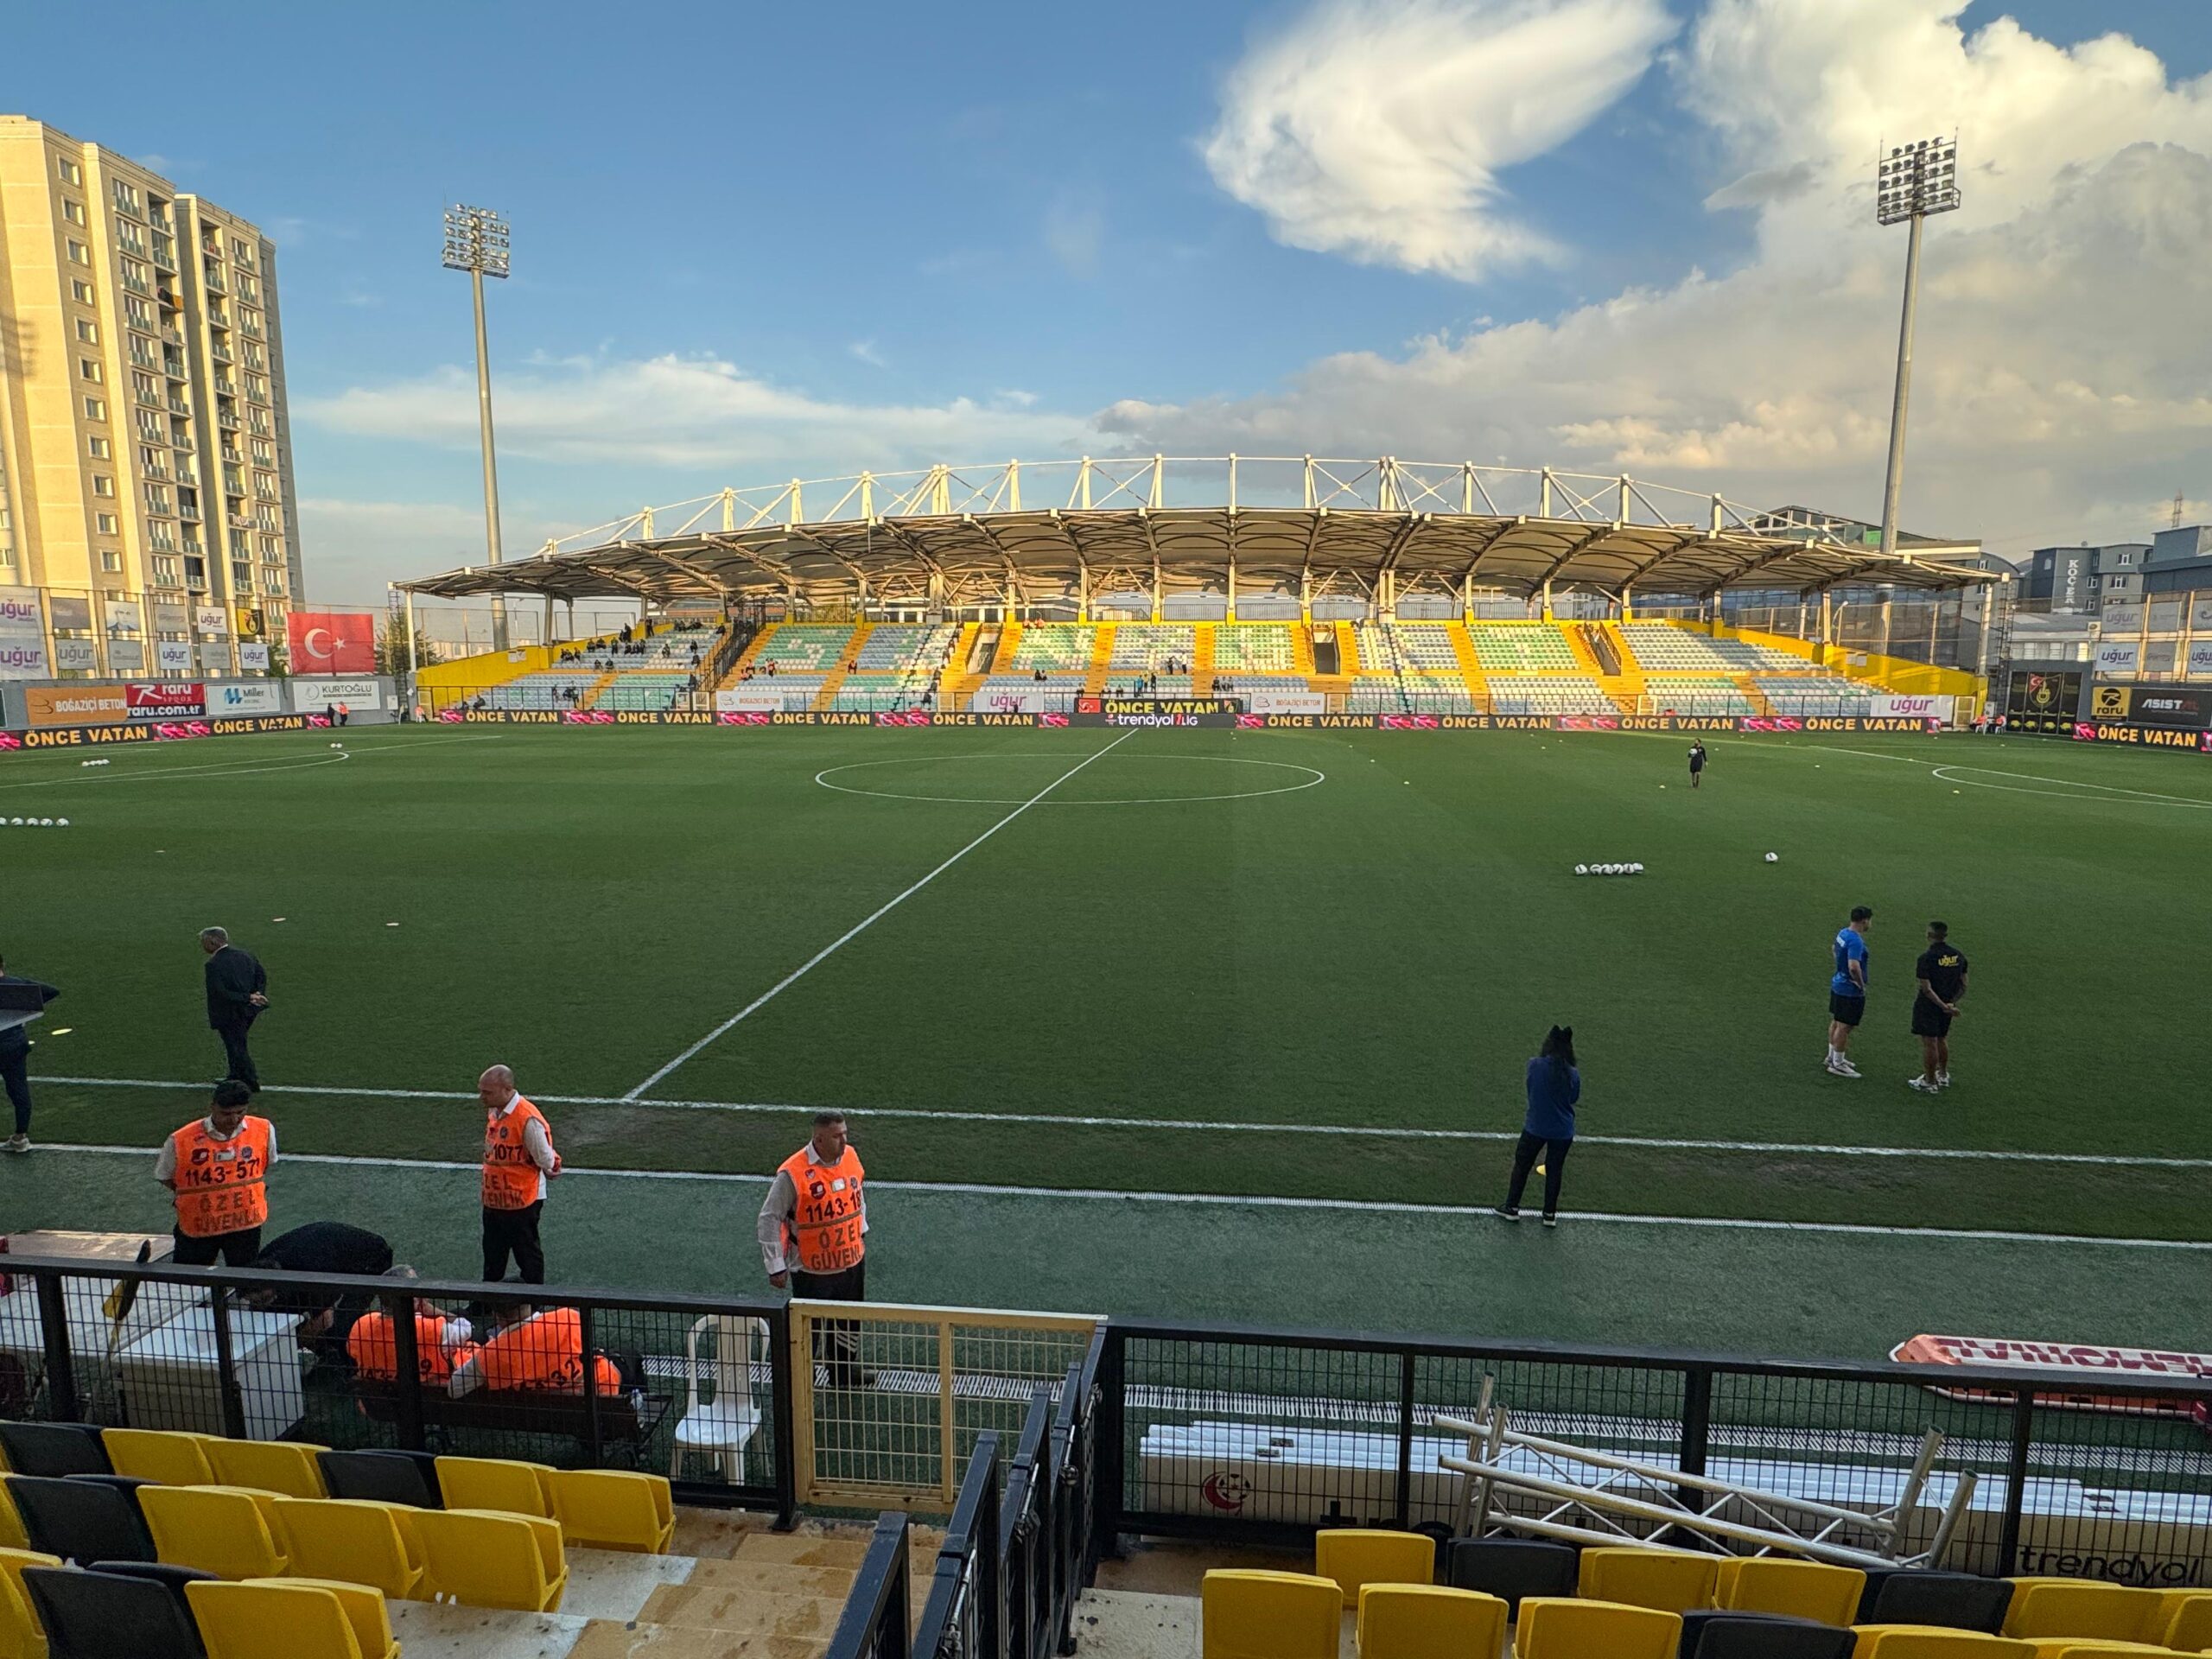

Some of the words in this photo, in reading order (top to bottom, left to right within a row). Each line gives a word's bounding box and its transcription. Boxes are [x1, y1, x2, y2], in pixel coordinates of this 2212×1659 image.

[200, 613, 222, 626] uğur
[1, 646, 41, 666] uğur
[59, 645, 92, 662] uğur
[162, 648, 187, 662] uğur
[244, 650, 264, 661] uğur
[2101, 649, 2133, 664] uğur
[2191, 649, 2212, 664] uğu
[321, 683, 372, 694] KURTOĞLU
[99, 697, 127, 711] BETON
[127, 705, 200, 717] raru.com.tr
[1105, 700, 1155, 714] ÖNCE
[1160, 702, 1218, 714] VATAN
[1890, 695, 1934, 714] uğur
[2096, 706, 2123, 715] raru
[466, 709, 505, 722] ÖNCE
[511, 711, 558, 722] VATAN
[618, 710, 658, 723] ÖNCE
[664, 712, 712, 723] VATAN
[773, 711, 815, 724] ÖNCE
[820, 714, 870, 724] VATAN
[933, 713, 976, 725] ÖNCE
[982, 715, 1033, 725] VATAN
[1117, 714, 1174, 728] trendyol
[1268, 715, 1313, 728] ÖNCE
[1319, 716, 1373, 728] VATAN
[1442, 715, 1489, 728] ÖNCE
[1496, 717, 1551, 728] VATAN
[1621, 716, 1669, 729] ÖNCE
[1677, 718, 1733, 729] VATAN
[213, 720, 254, 734] ÖNCE
[259, 717, 302, 730] VATAN
[1806, 717, 1855, 730] ÖNCE
[1863, 719, 1922, 731] VATAN
[25, 730, 81, 747] ÖNCE
[87, 726, 148, 742] VATAN
[2098, 724, 2139, 742] ÖNCE
[2144, 729, 2196, 747] VATAN
[2020, 1546, 2199, 1585] trendyol
